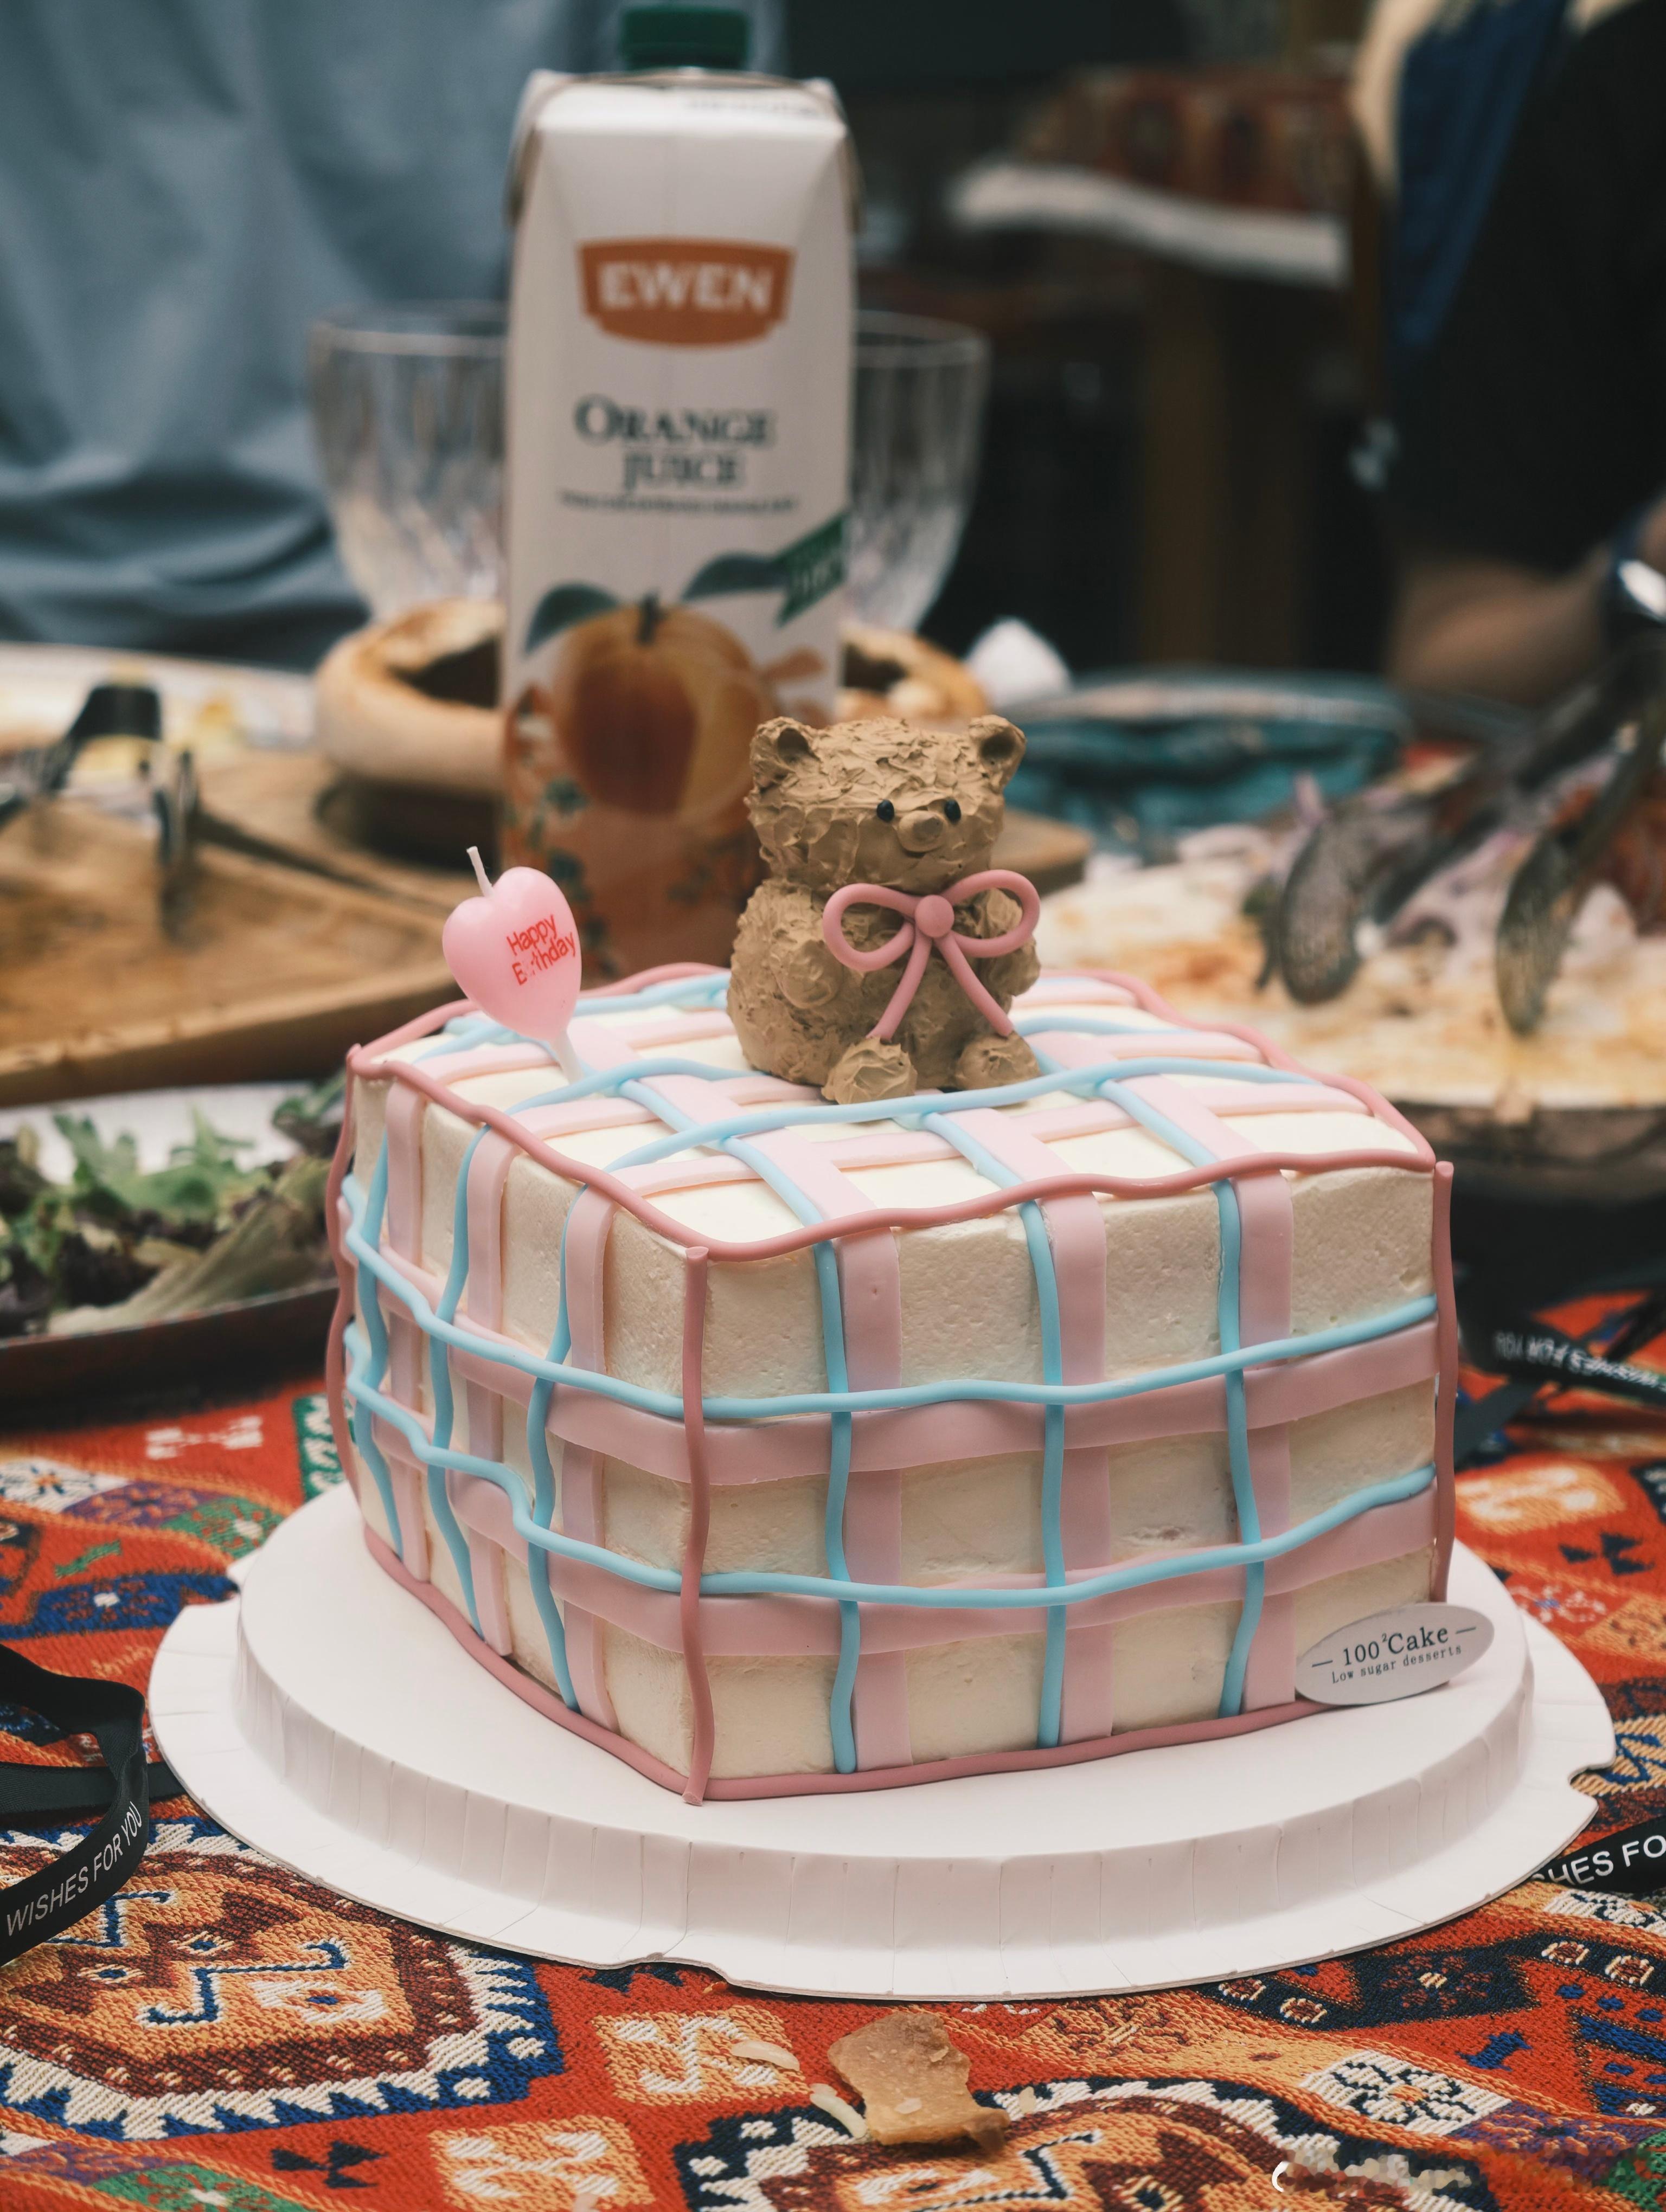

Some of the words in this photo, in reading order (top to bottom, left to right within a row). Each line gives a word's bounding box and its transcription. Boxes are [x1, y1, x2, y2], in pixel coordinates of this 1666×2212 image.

[599, 262, 774, 314] EWEN
[624, 451, 742, 494] JUICE
[507, 914, 557, 955] Happy
[1332, 1671, 1354, 1684] Low
[1361, 1660, 1396, 1676] sugar
[1403, 1645, 1462, 1667] desserts
[7, 1866, 88, 1937] WISHES
[94, 1833, 123, 1882] FOR
[121, 1801, 142, 1846] YOU
[1530, 1850, 1614, 1886] HES
